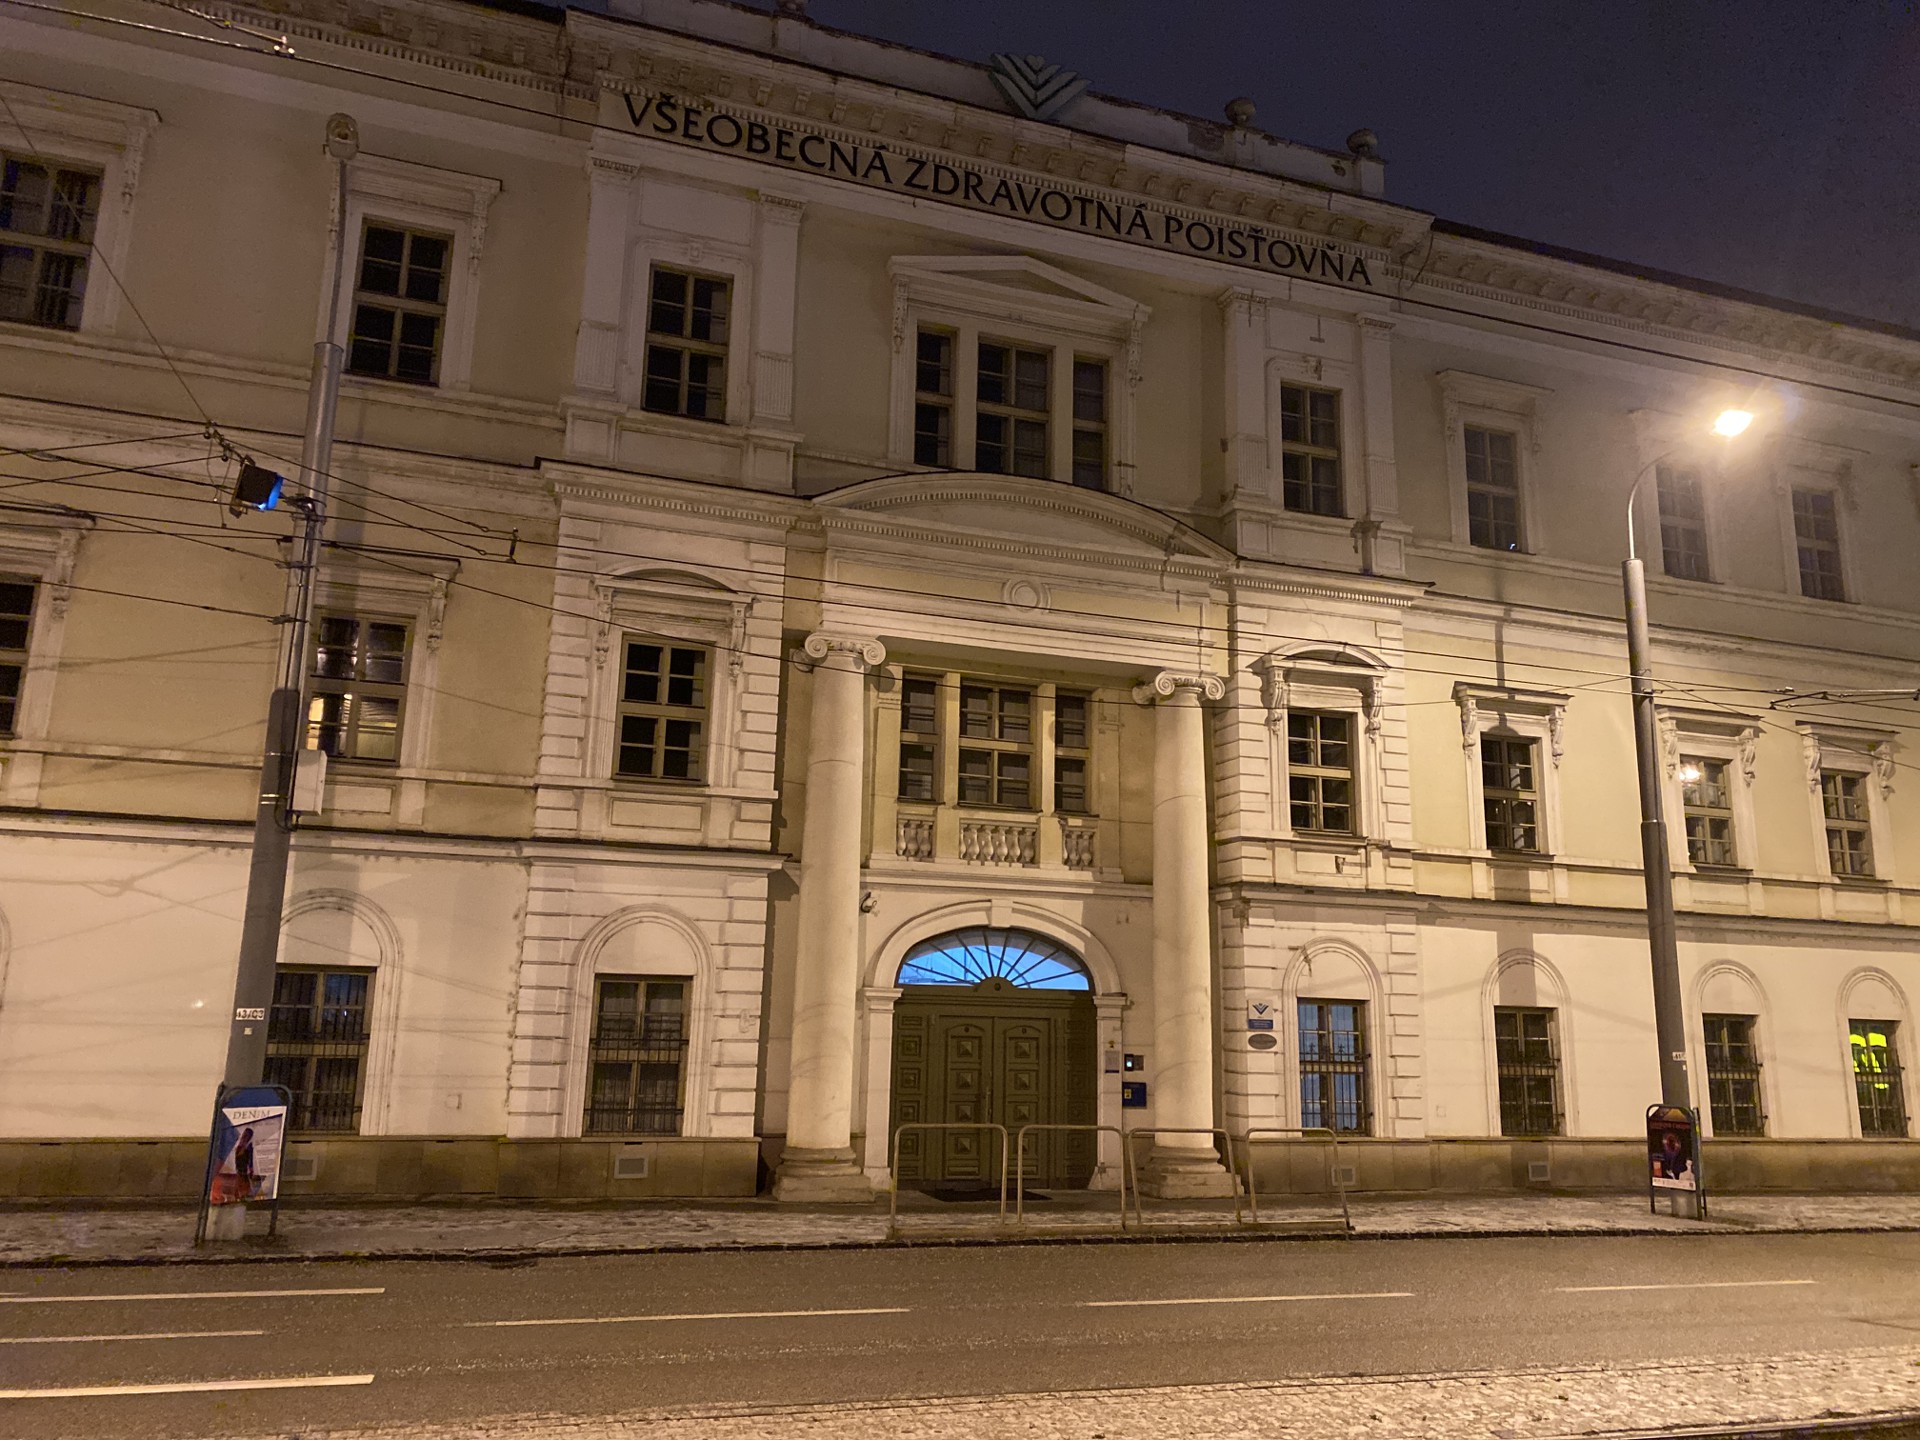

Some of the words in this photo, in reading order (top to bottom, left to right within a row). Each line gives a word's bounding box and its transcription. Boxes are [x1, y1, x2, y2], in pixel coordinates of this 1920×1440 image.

[624, 92, 893, 184] VŠEOBECNÁ
[904, 157, 1152, 240] ZDRAVOTNÁ
[1163, 214, 1373, 286] POISŤOVŇA
